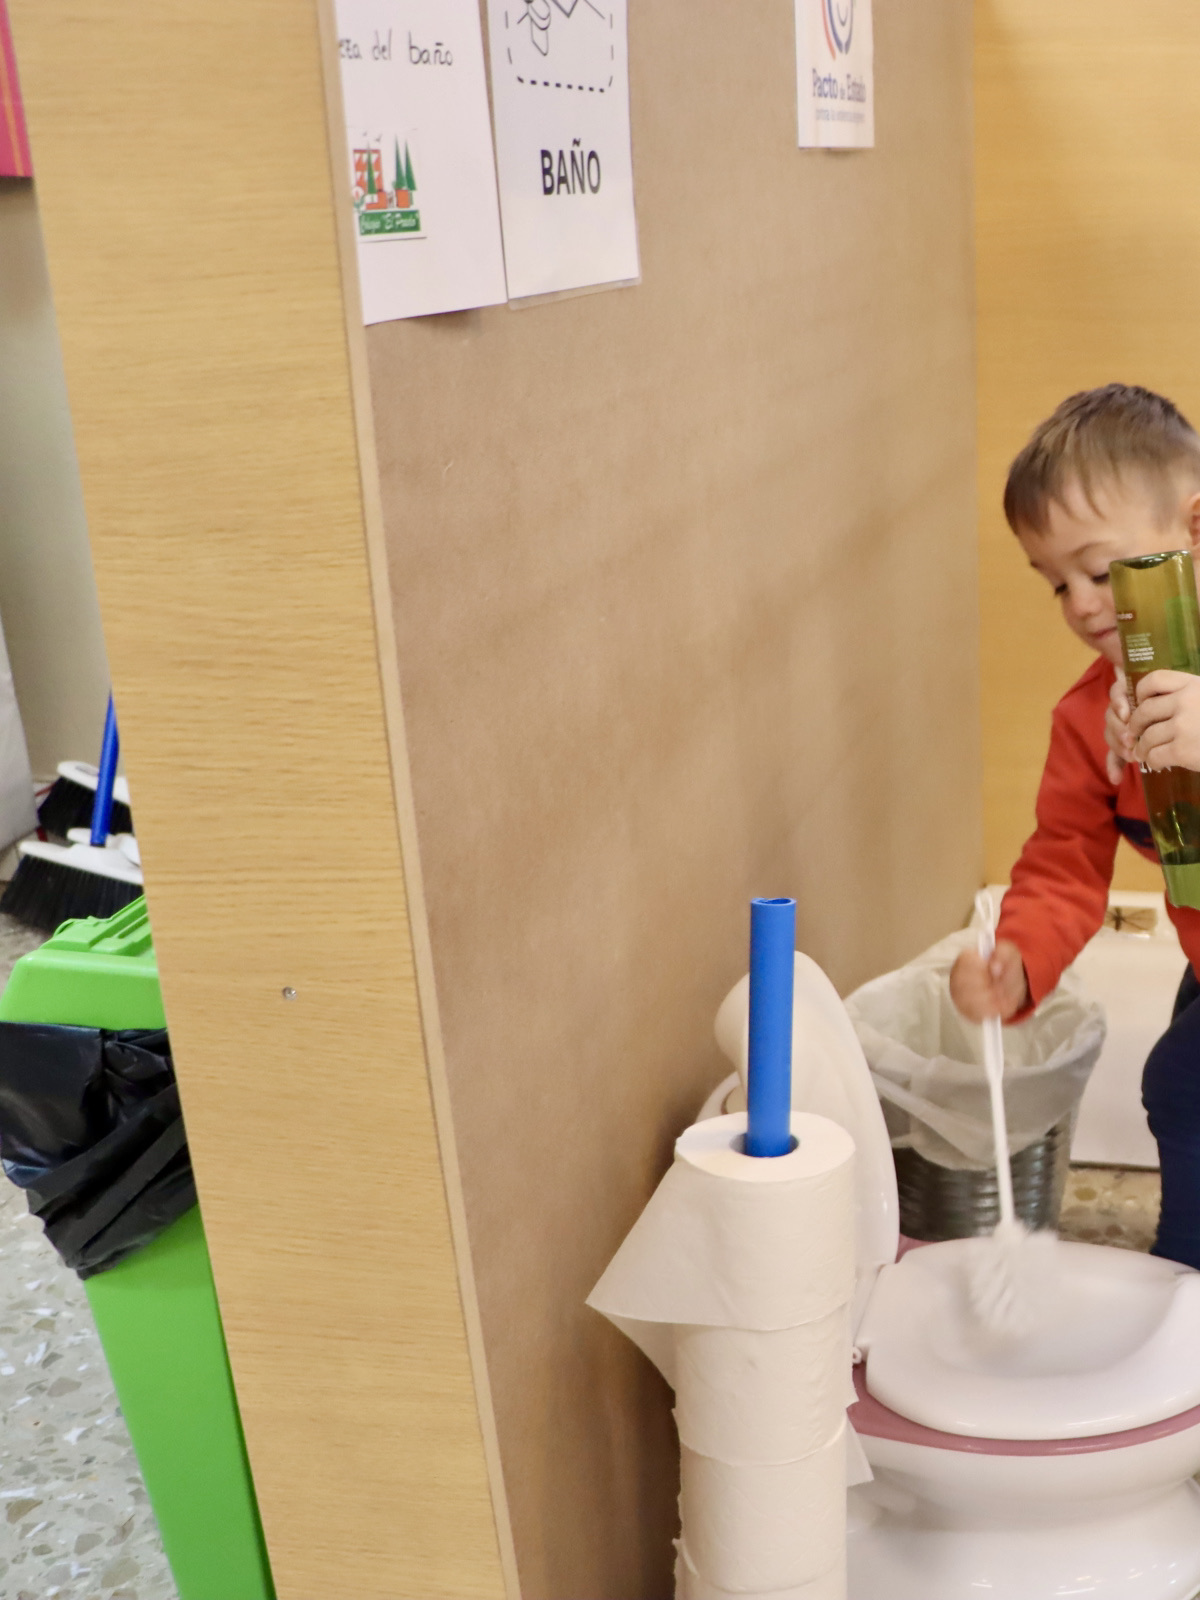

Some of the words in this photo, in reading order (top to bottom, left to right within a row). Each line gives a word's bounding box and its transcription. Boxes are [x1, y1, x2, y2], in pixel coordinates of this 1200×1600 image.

[372, 27, 392, 61] del
[408, 29, 453, 66] baño
[812, 67, 838, 98] Pacto
[540, 137, 601, 196] BAÑO
